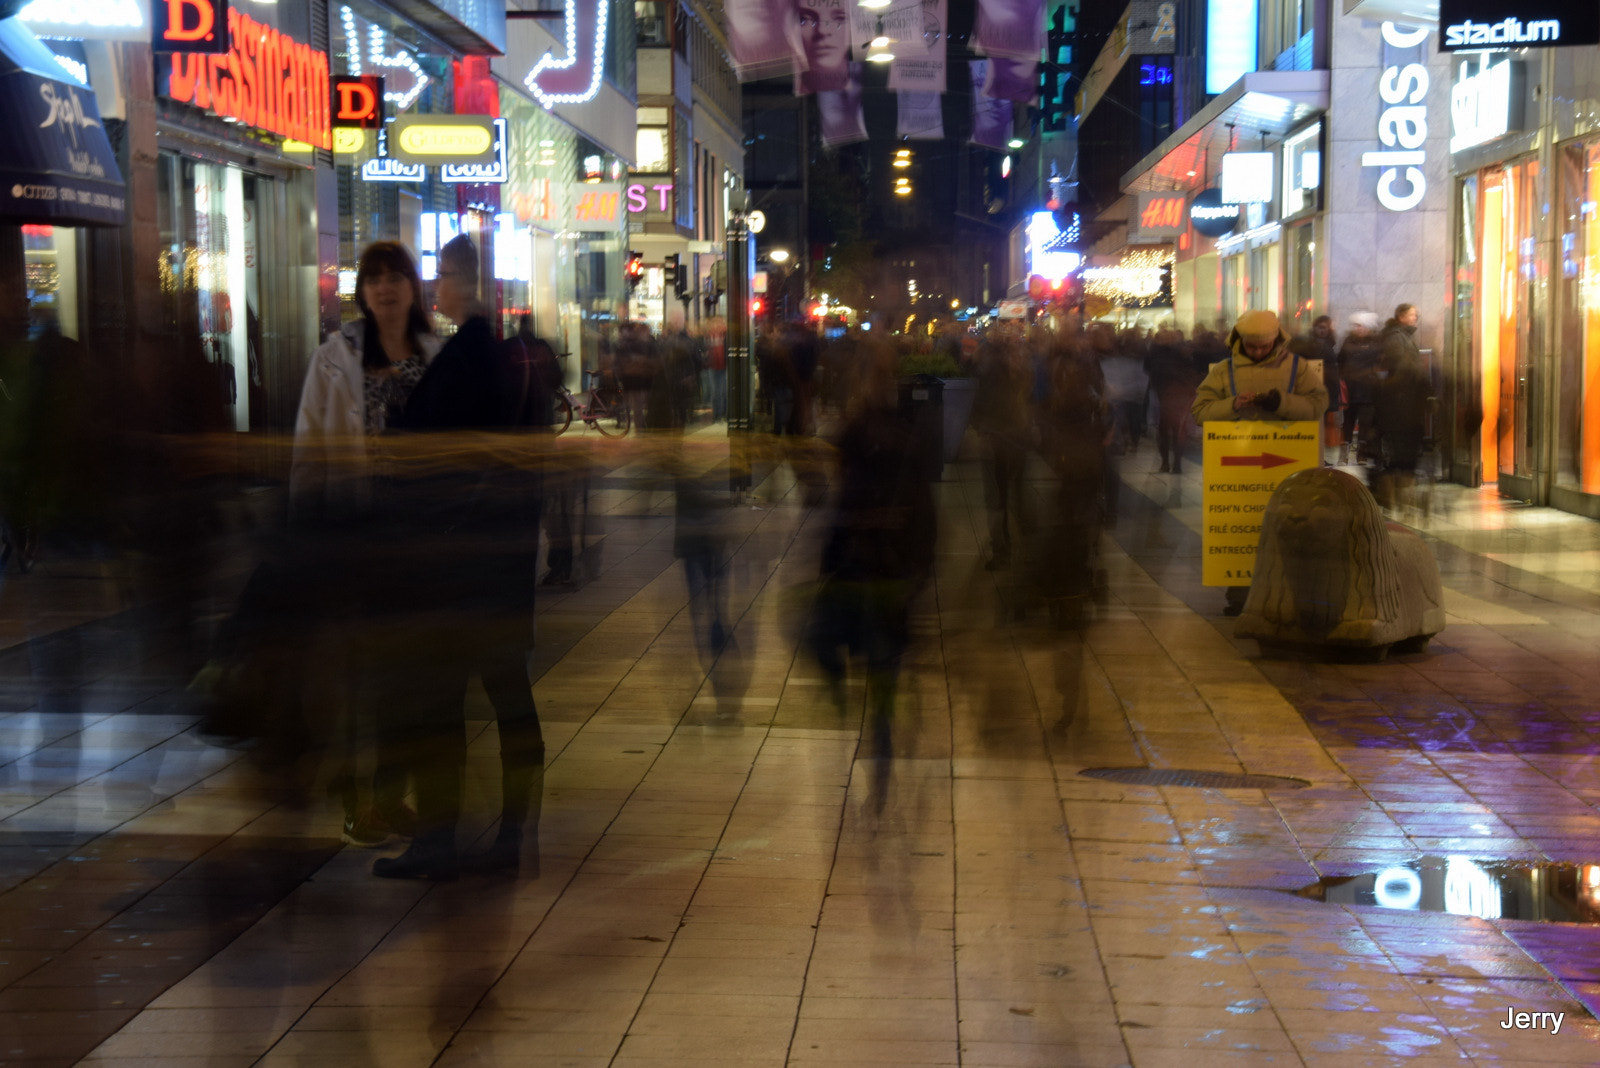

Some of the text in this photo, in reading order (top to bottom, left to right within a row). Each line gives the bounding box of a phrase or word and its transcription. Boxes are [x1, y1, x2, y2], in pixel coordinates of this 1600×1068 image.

[1445, 17, 1560, 46] stadium
[1361, 62, 1430, 212] clas
[1140, 197, 1185, 229] H&M
[1207, 431, 1315, 441] Restaurant London
[1209, 482, 1275, 492] KYCKLINGFILÉ
[1209, 523, 1227, 533] FILÉ
